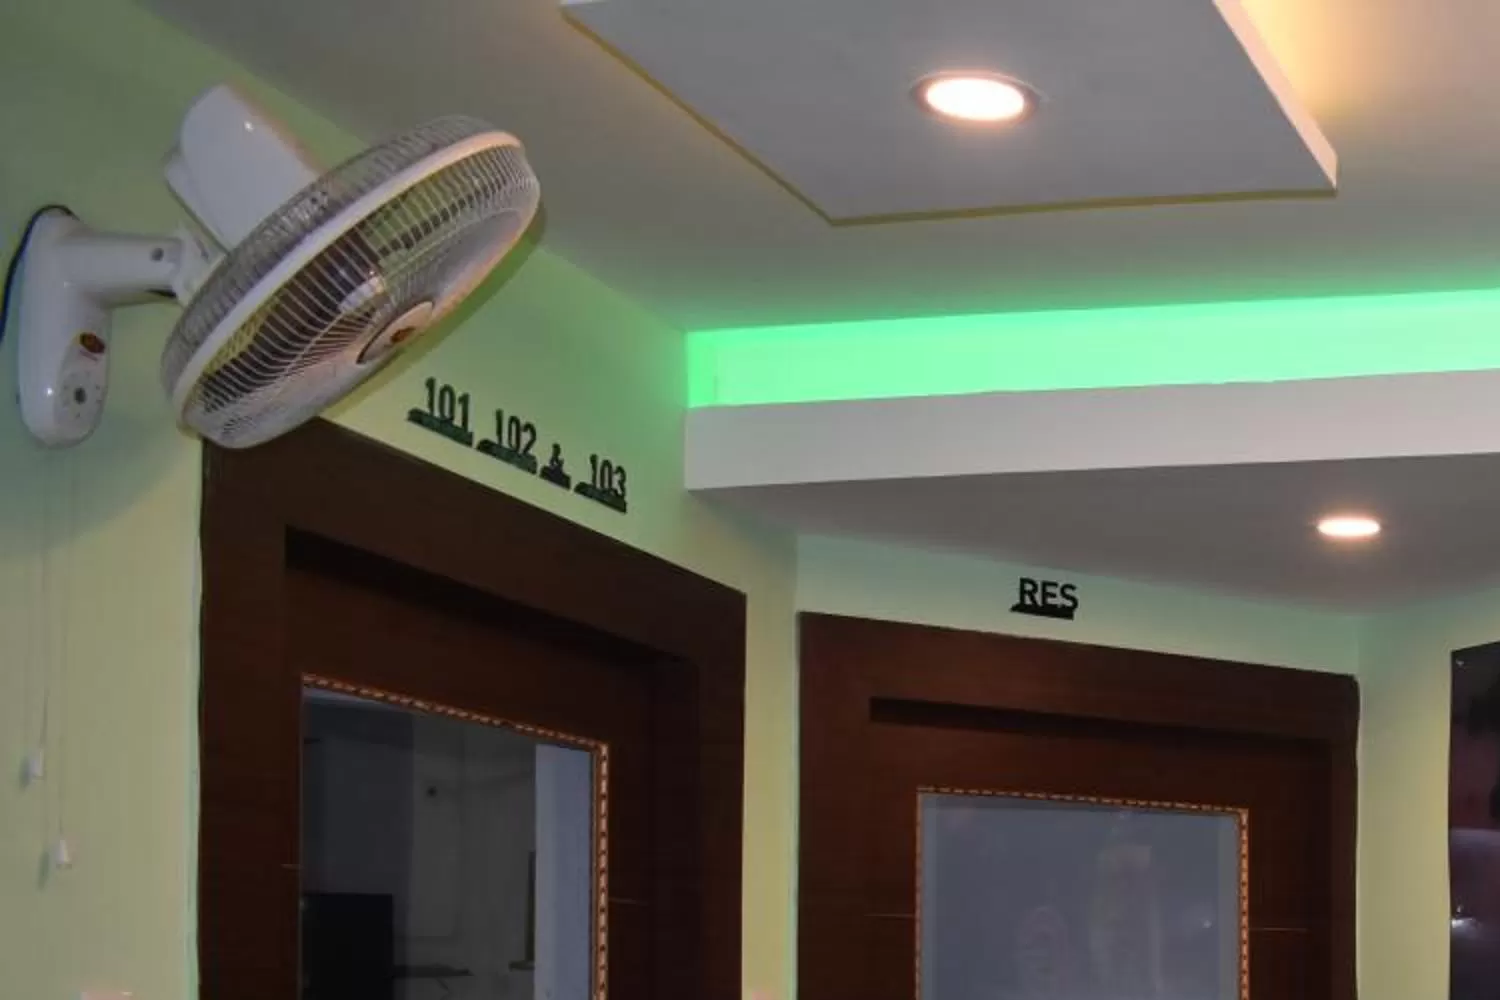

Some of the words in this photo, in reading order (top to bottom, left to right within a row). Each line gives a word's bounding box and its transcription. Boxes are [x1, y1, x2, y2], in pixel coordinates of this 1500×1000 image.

[422, 377, 472, 435] 101
[492, 409, 538, 458] 102
[586, 454, 627, 502] 103
[1018, 577, 1079, 610] RES
